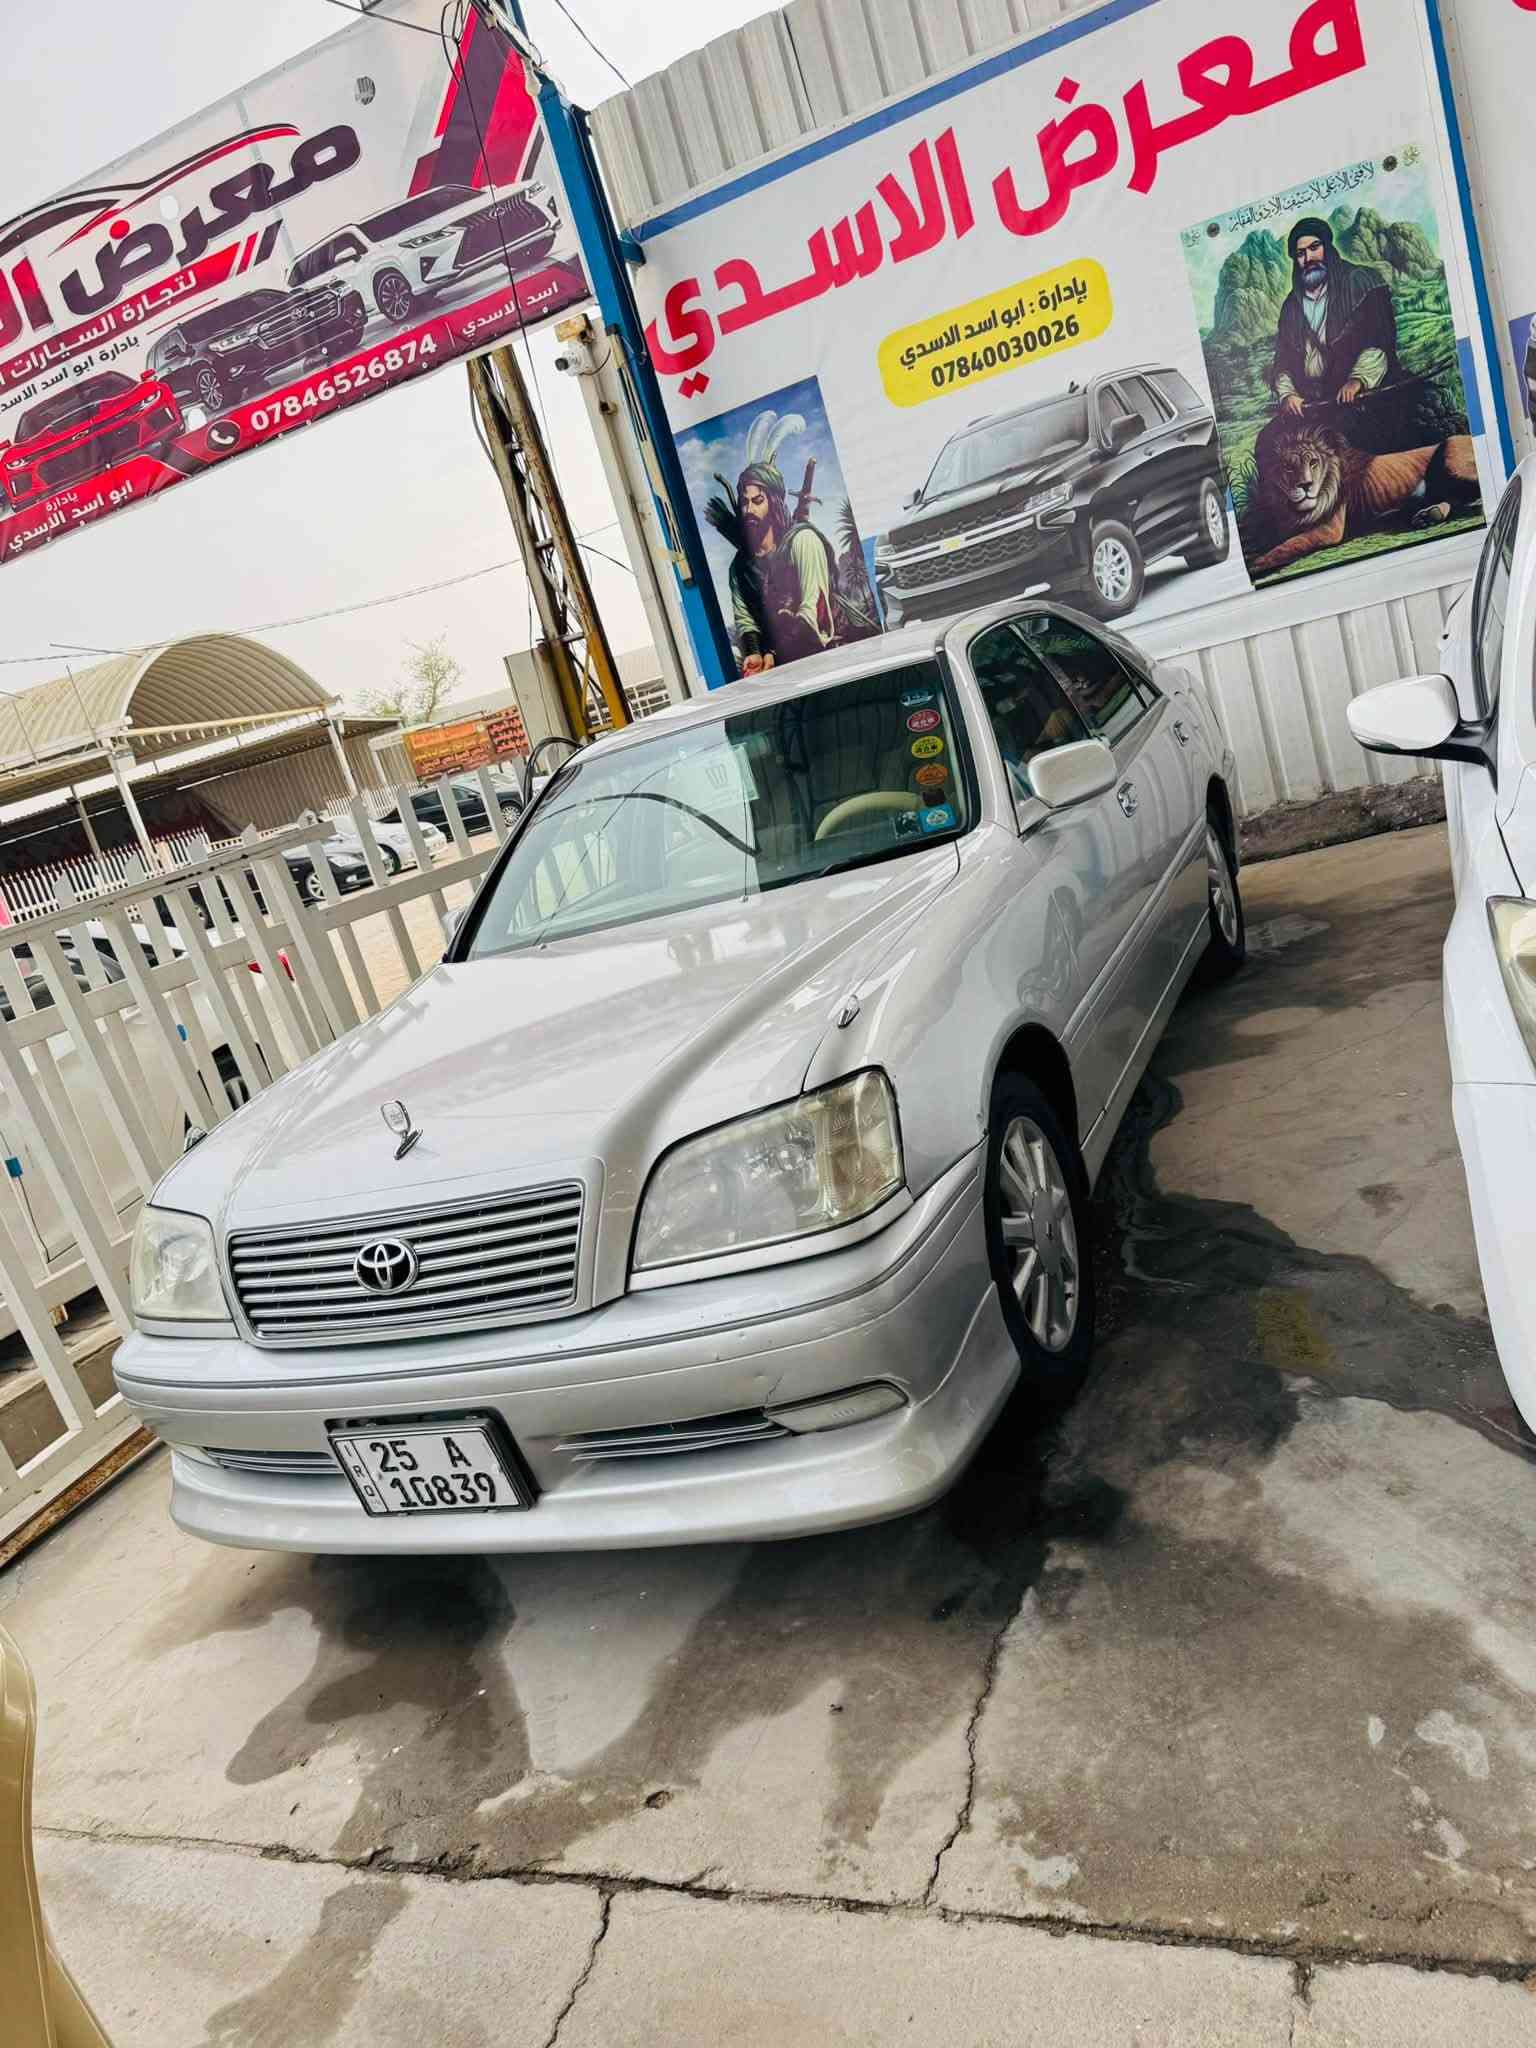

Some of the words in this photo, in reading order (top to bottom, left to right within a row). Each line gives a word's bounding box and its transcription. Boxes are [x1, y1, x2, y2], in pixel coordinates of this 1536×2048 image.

[991, 0, 1367, 237] معرض
[59, 124, 361, 316] معرض
[643, 126, 976, 399] الاسدي
[121, 270, 197, 323] لتجارة
[526, 280, 559, 306] اسد
[964, 309, 998, 340] اسد
[1001, 299, 1026, 328] ابو
[10, 313, 116, 379] السيارات
[899, 324, 962, 370] الاسدي
[931, 314, 1080, 387] 07840030026
[41, 367, 69, 390] اسد
[73, 355, 95, 377] ابو
[250, 333, 438, 432] 07846526874
[0, 383, 38, 414] الاسد
[72, 493, 105, 519] اسد
[109, 480, 133, 505] ابو
[9, 510, 67, 552] الاسدي
[369, 1439, 419, 1473] 25
[442, 1437, 473, 1469] A
[389, 1471, 497, 1509] 10839
